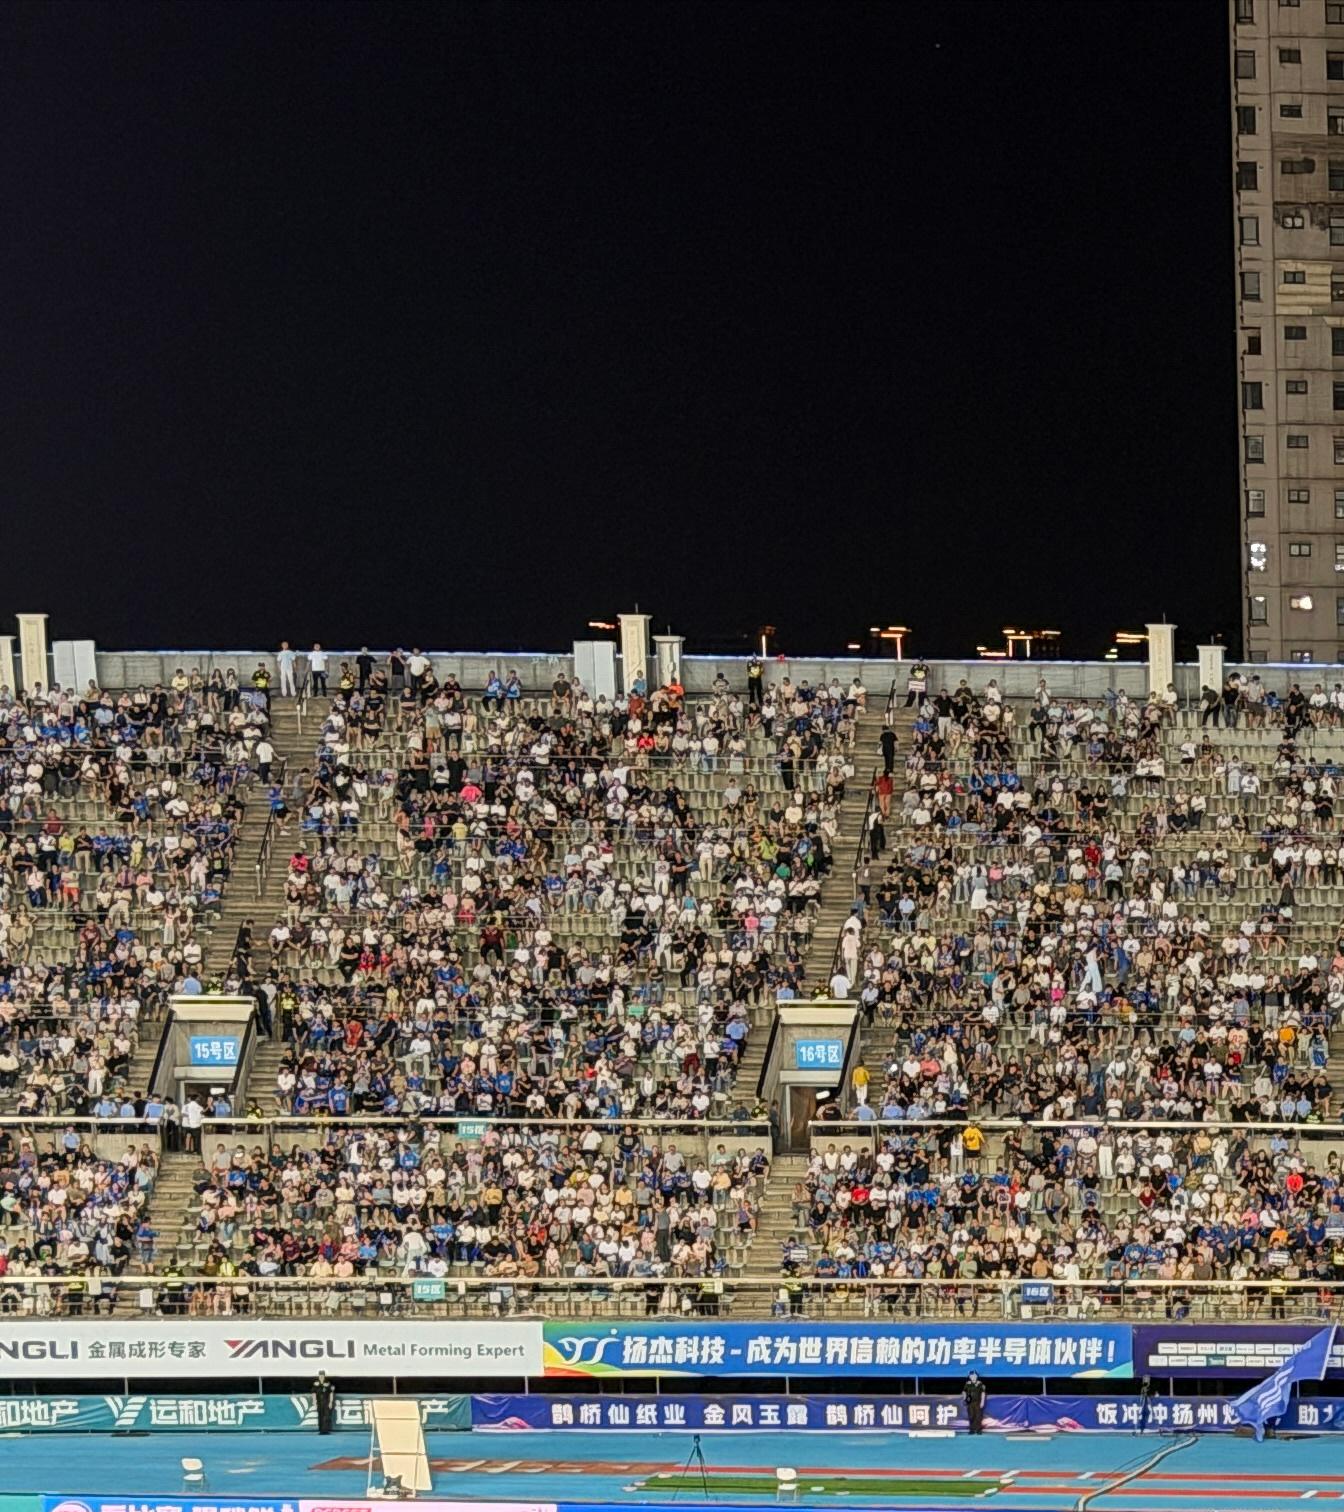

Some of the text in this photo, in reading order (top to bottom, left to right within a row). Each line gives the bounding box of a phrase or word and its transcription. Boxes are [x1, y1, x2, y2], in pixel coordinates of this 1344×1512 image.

[194, 1042, 236, 1059] 15号区
[799, 1045, 840, 1063] 16号区
[88, 1340, 207, 1359] 金属成形专家
[224, 1339, 525, 1359] YANGLI Metal Forming Expert
[151, 1400, 265, 1426] 运和地产
[704, 1404, 808, 1426] 金风玉露
